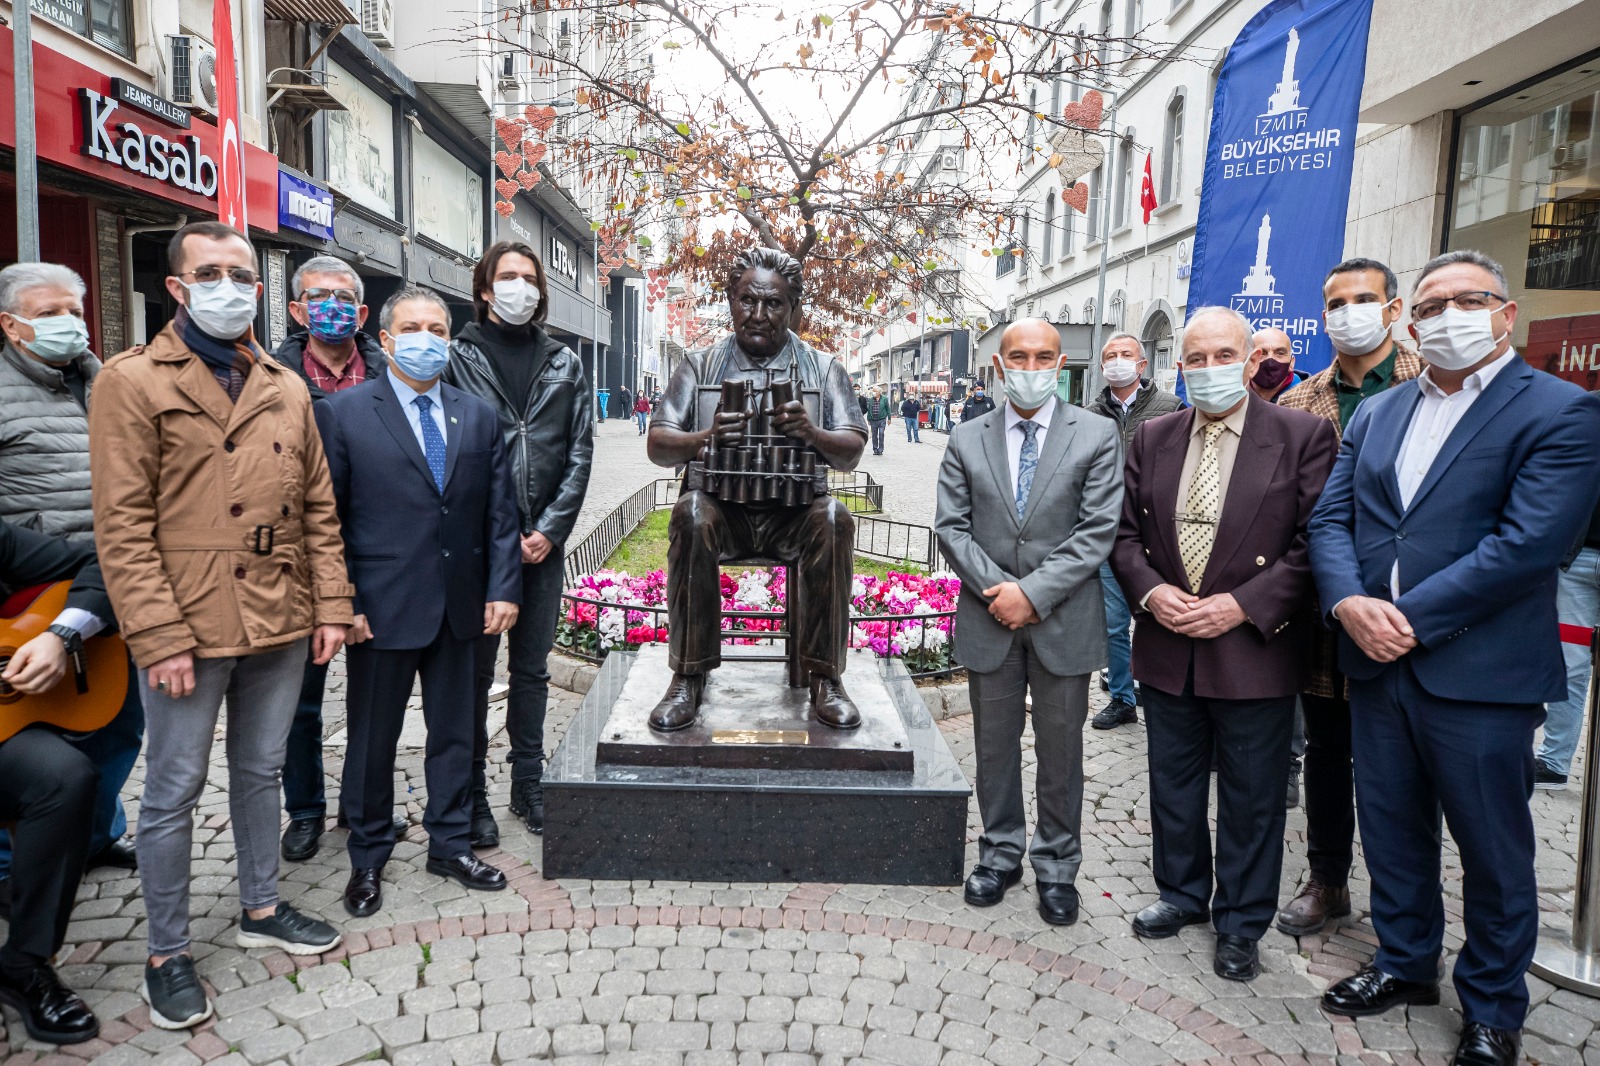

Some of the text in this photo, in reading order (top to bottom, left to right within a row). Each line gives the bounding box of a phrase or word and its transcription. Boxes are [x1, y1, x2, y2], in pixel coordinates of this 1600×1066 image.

[125, 85, 187, 124] JEANS GALLERY
[1255, 112, 1308, 136] İZMİR
[86, 87, 218, 197] Kasab
[1221, 127, 1341, 160] BÜYÜKŞEHİR
[1223, 150, 1332, 179] BELEDİYESİ
[288, 190, 332, 228] mavi
[552, 236, 568, 275] LTB
[1230, 297, 1284, 314] İZMİR
